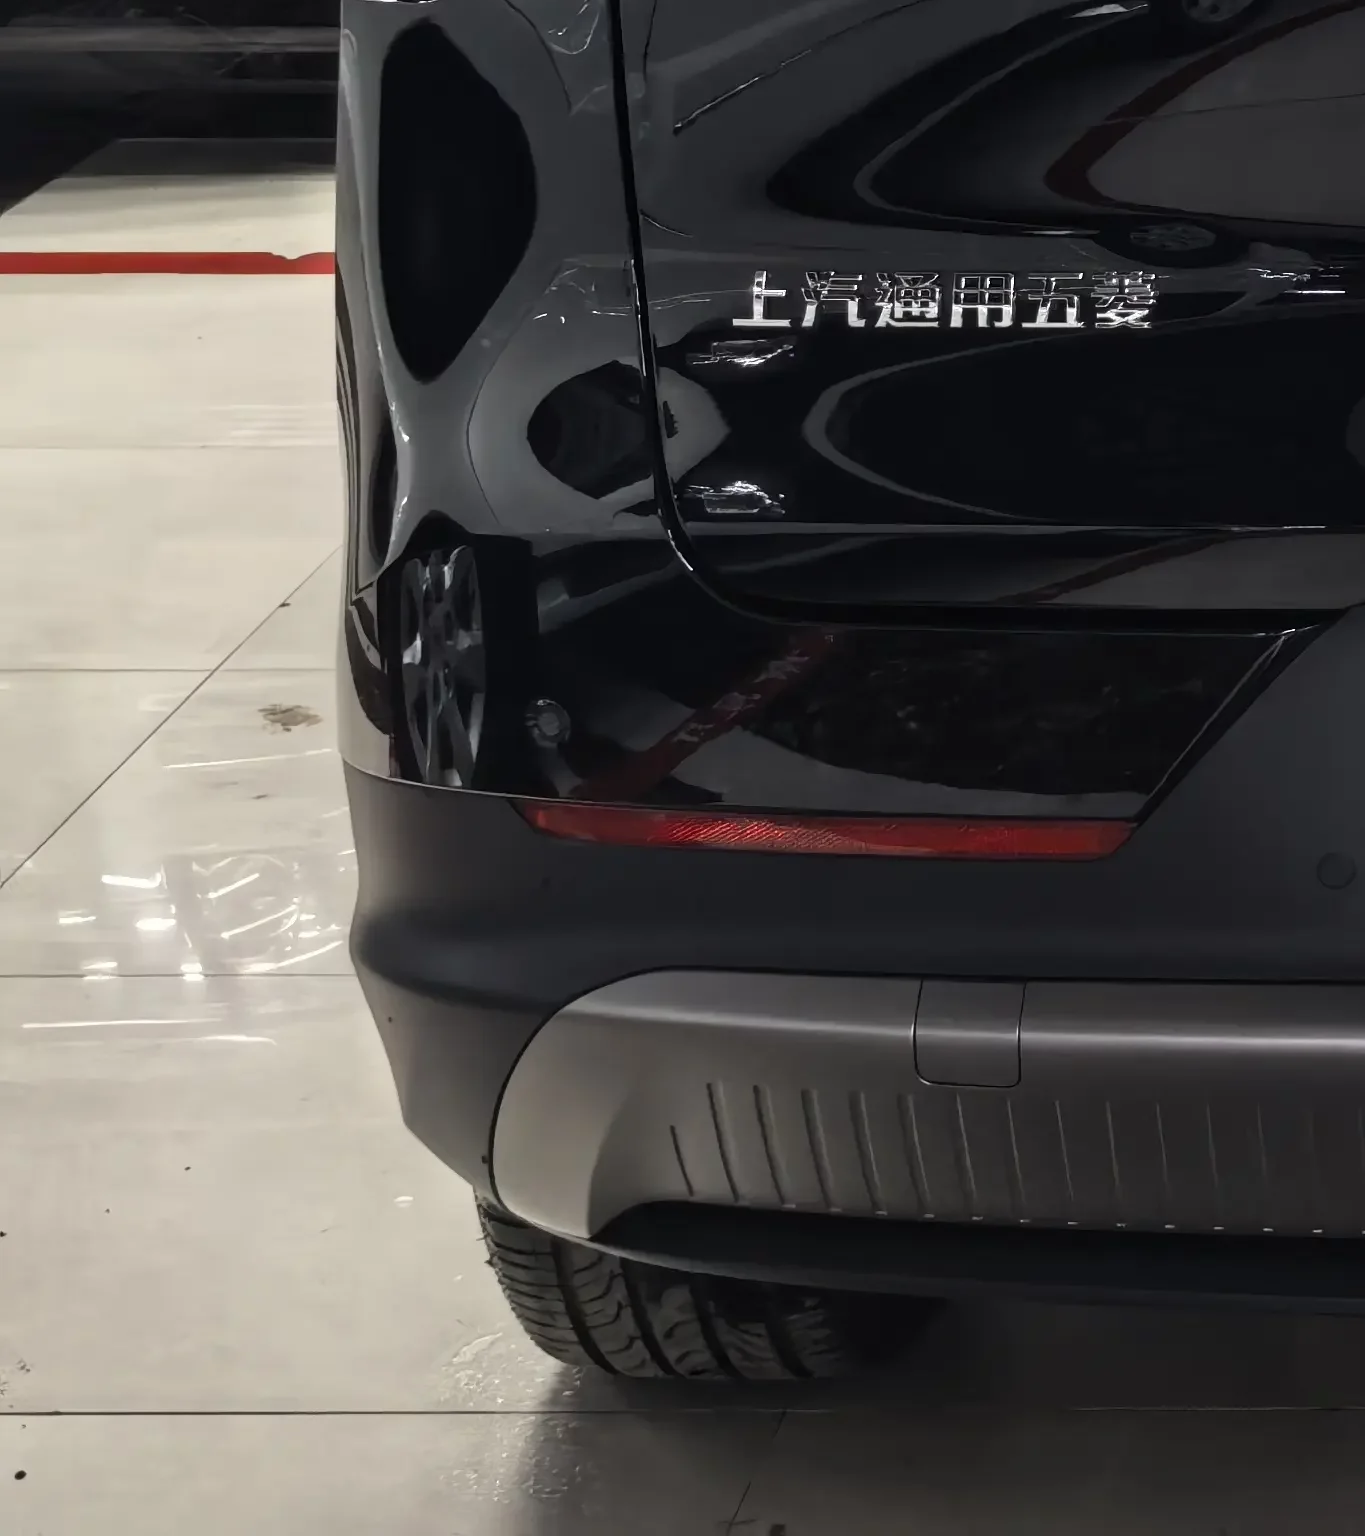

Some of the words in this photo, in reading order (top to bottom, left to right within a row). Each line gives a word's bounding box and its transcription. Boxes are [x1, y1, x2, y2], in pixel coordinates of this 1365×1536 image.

[732, 270, 1158, 329] 上汽通用五菱
